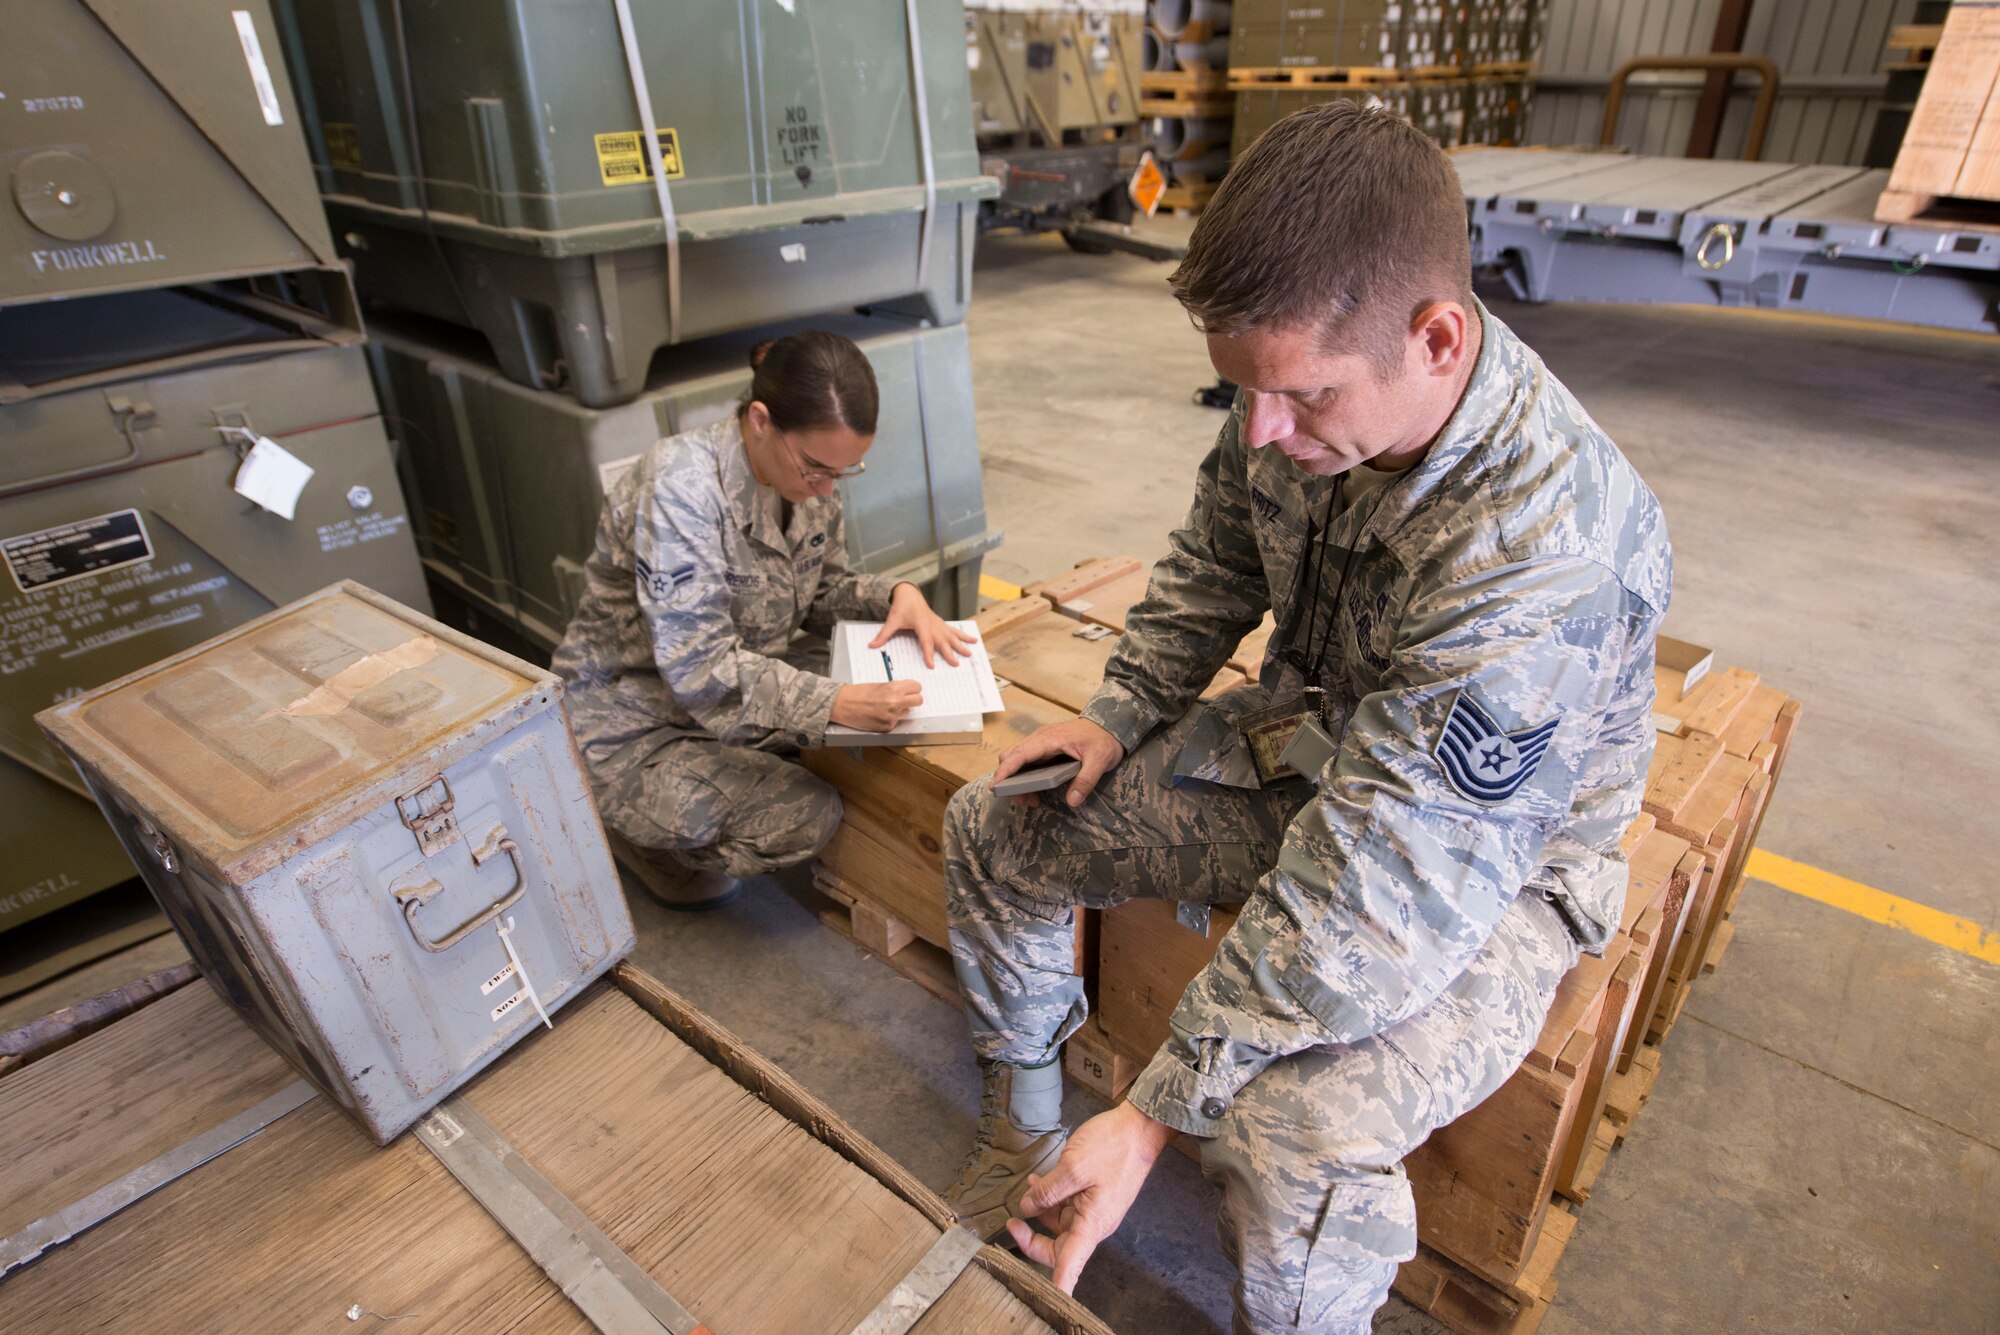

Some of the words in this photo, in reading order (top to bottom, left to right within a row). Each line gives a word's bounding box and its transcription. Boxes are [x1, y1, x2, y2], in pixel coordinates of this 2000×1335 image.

[785, 106, 807, 123] NO
[776, 125, 820, 145] FORK
[782, 144, 818, 164] LIFT
[31, 240, 167, 272] FORKWELL
[1252, 486, 1281, 523] FRITZ
[496, 995, 519, 1014] NONE
[1083, 1057, 1103, 1079] PB
